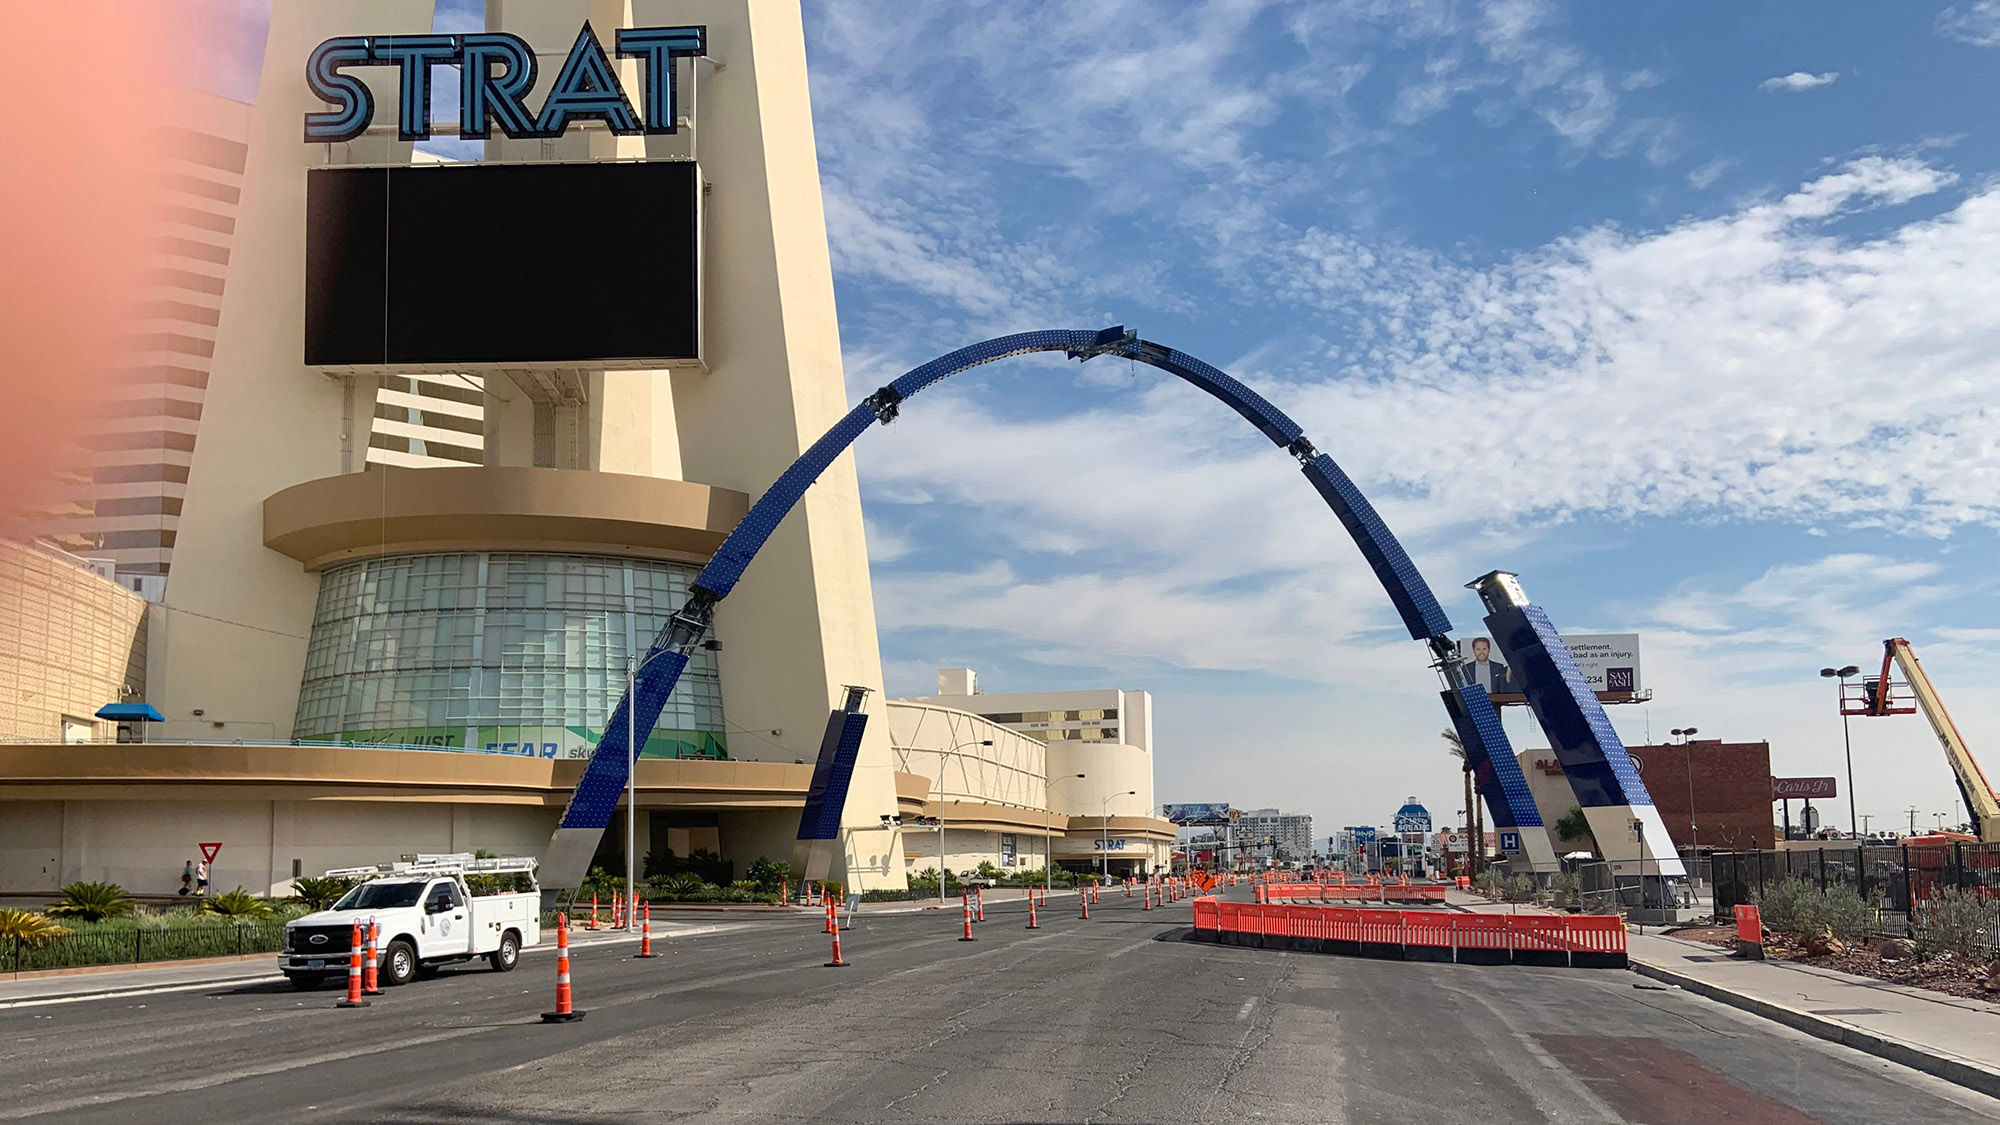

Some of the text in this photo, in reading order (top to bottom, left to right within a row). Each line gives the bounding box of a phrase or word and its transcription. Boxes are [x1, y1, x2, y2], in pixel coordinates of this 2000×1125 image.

[304, 19, 707, 143] STRAT
[1535, 759, 1561, 770] ALA
[1094, 839, 1126, 850] STRAT
[1504, 835, 1516, 848] H
